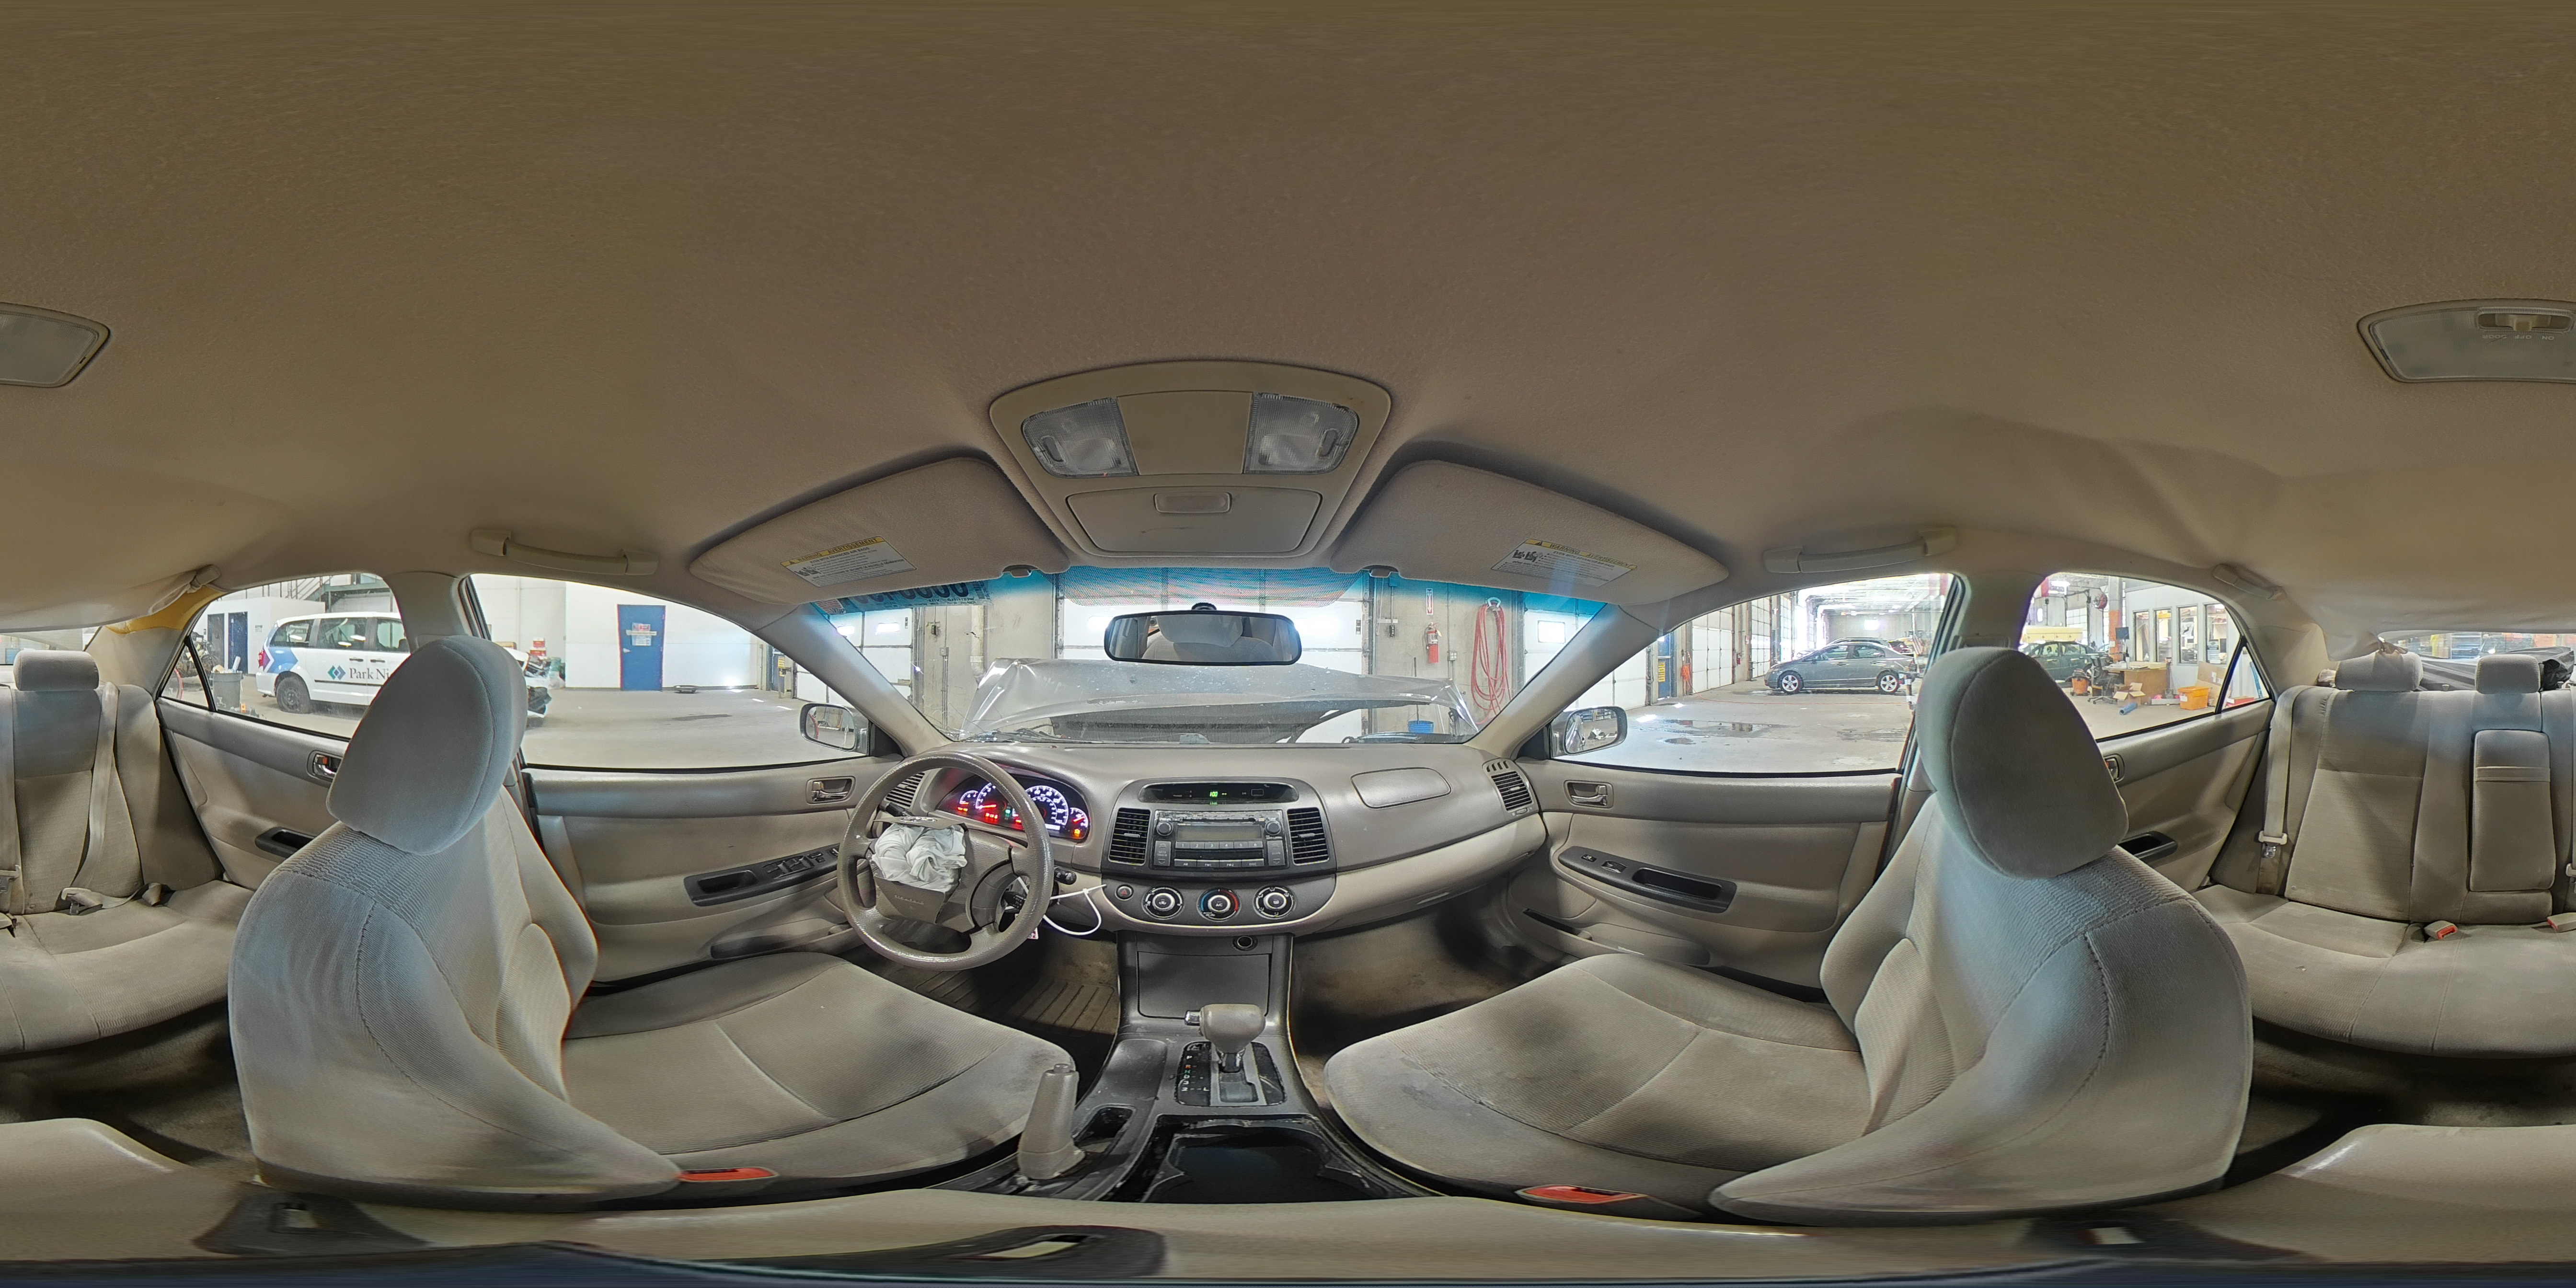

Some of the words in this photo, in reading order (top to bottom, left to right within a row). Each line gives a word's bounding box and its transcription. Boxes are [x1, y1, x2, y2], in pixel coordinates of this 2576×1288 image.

[797, 552, 822, 562] WARNING
[827, 538, 878, 554] AVERTISSEMENT
[1550, 543, 1581, 554] WARNING
[1587, 553, 1632, 567] AVERTISSEMENT
[349, 667, 374, 679] Park
